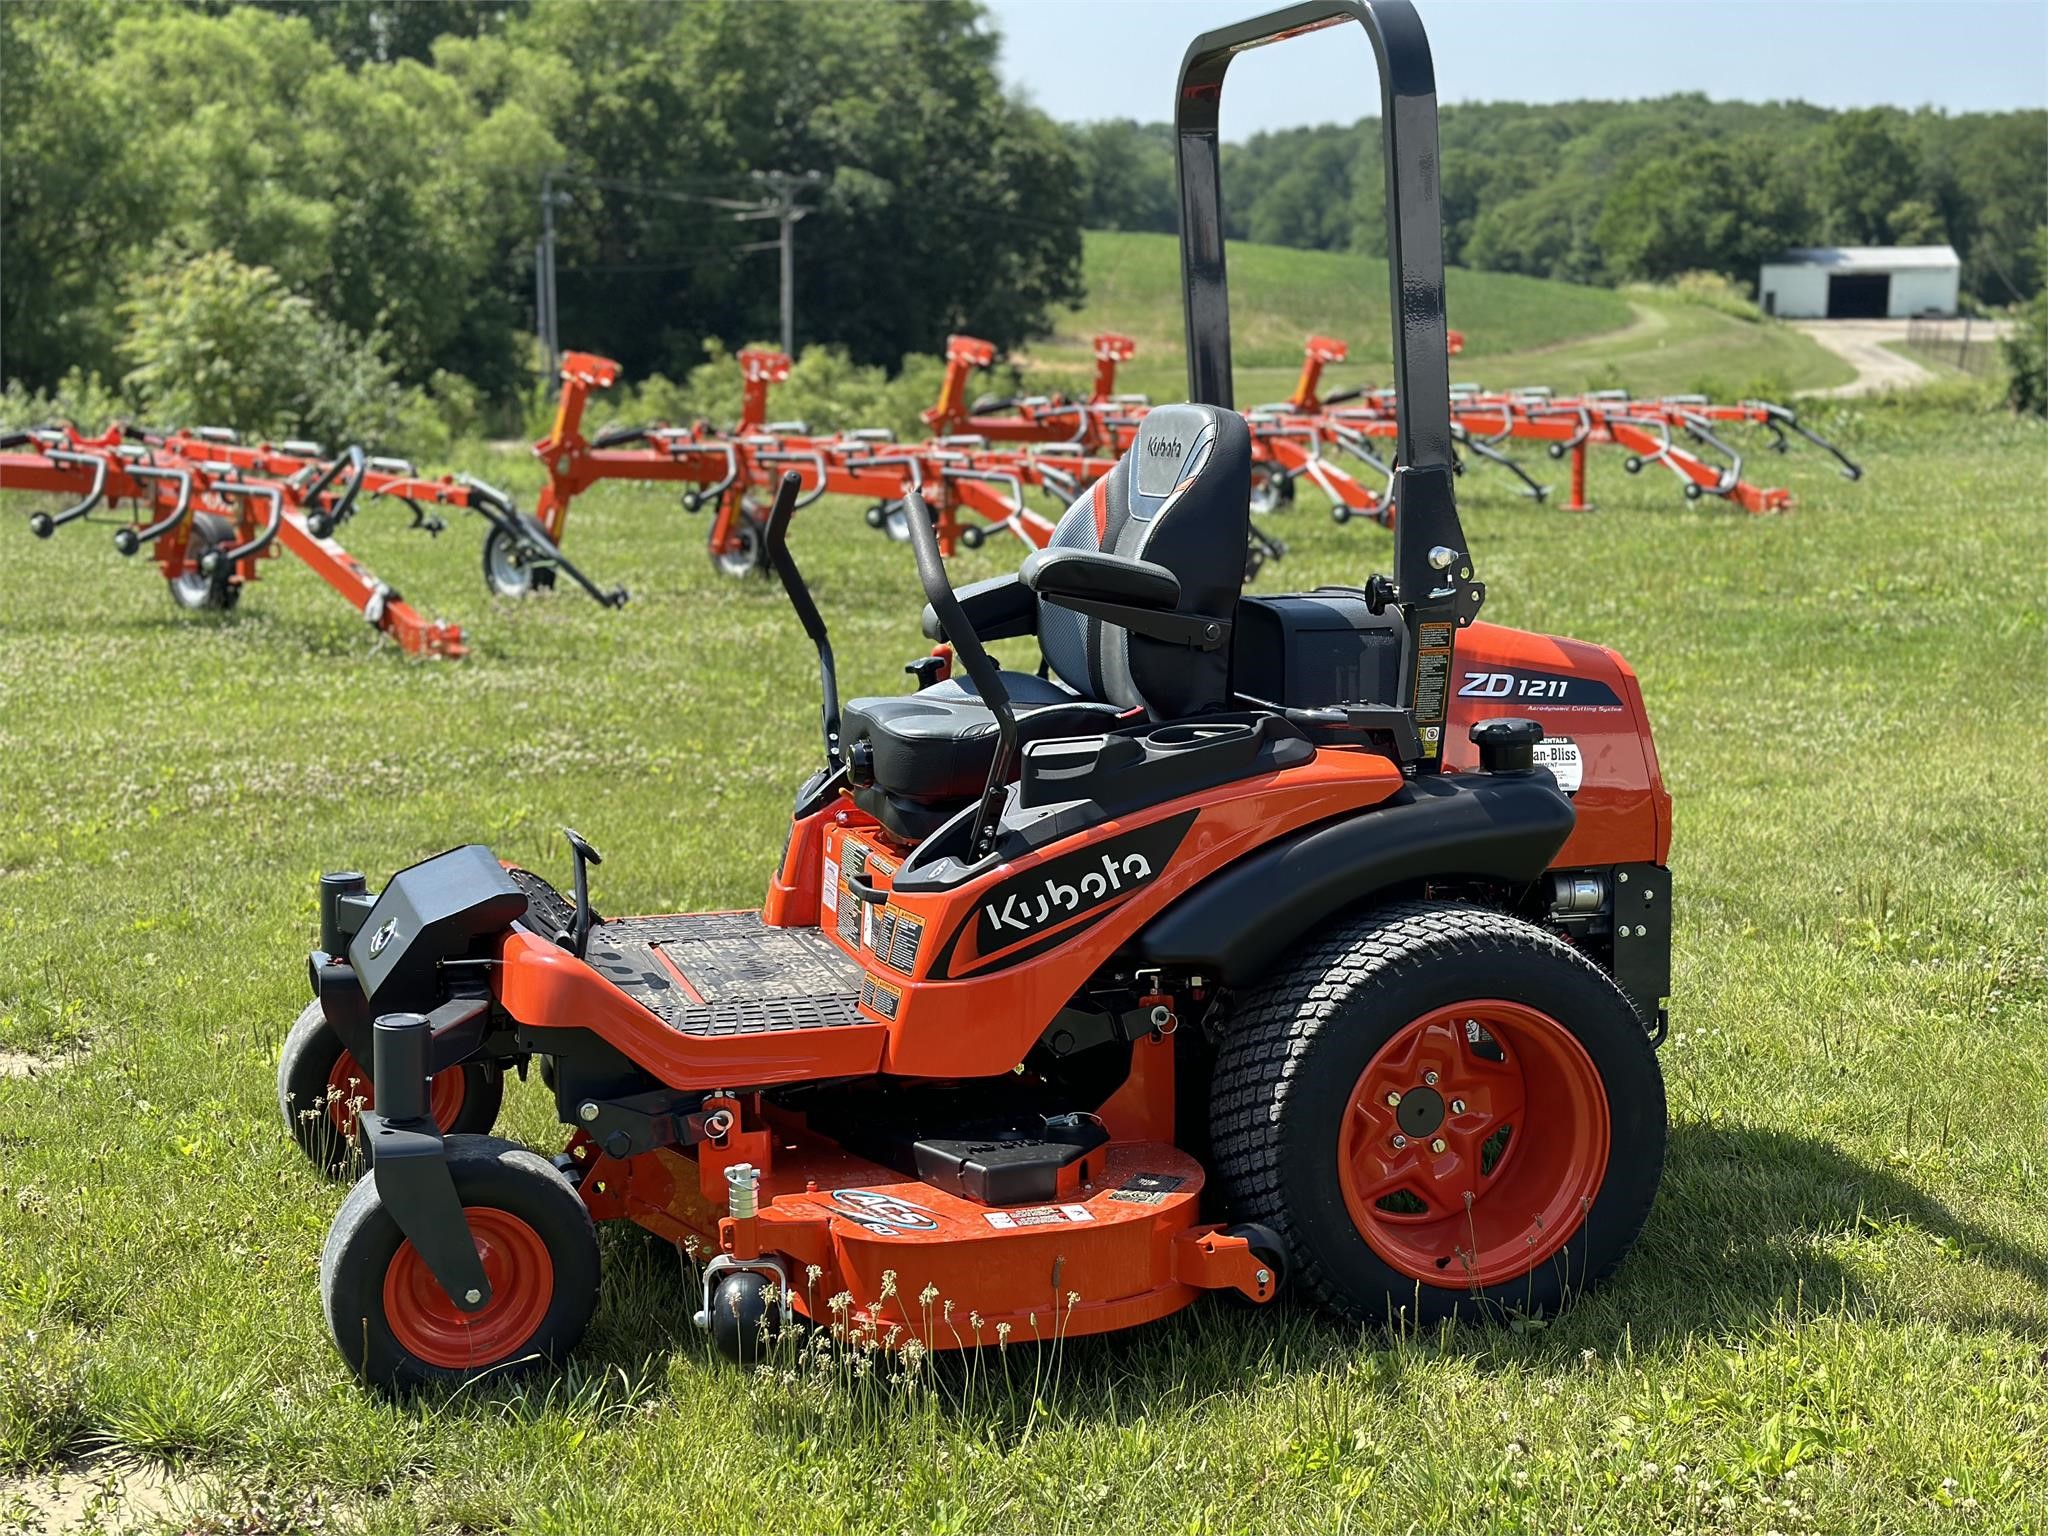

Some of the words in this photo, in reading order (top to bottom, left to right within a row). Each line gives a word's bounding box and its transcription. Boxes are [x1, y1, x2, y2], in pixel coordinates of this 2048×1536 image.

[1147, 436, 1182, 458] Kubota
[1457, 672, 1514, 697] ZD
[1517, 679, 1568, 698] 1211
[1527, 705, 1569, 713] Aerodynamic
[1571, 705, 1597, 713] Cutting
[1598, 705, 1623, 713] System
[985, 852, 1152, 931] Kubota
[841, 1193, 933, 1224] ACS
